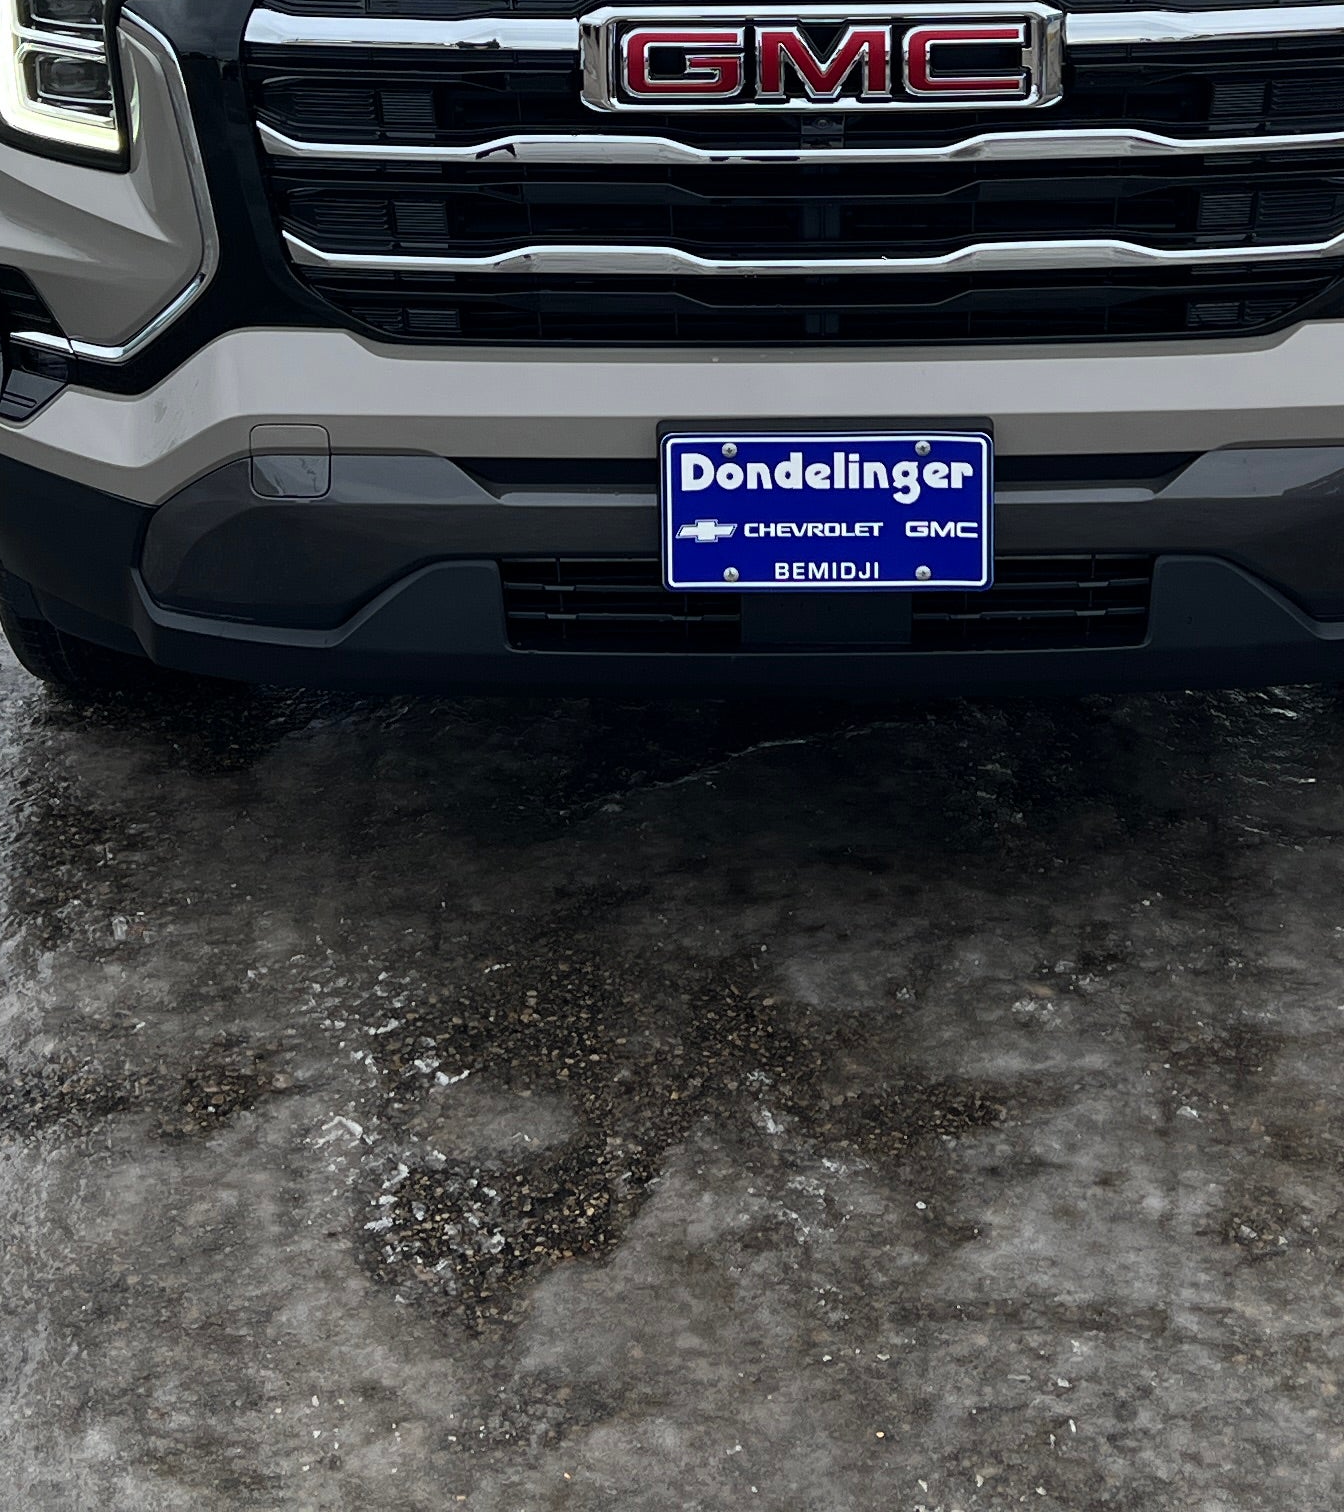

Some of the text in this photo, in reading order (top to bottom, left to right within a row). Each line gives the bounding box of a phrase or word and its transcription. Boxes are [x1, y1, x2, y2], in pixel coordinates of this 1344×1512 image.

[621, 24, 1027, 99] GMC
[680, 451, 974, 505] Dondelinger
[744, 521, 978, 538] CHEVROLET GMC
[774, 562, 880, 580] BEMIDJI
